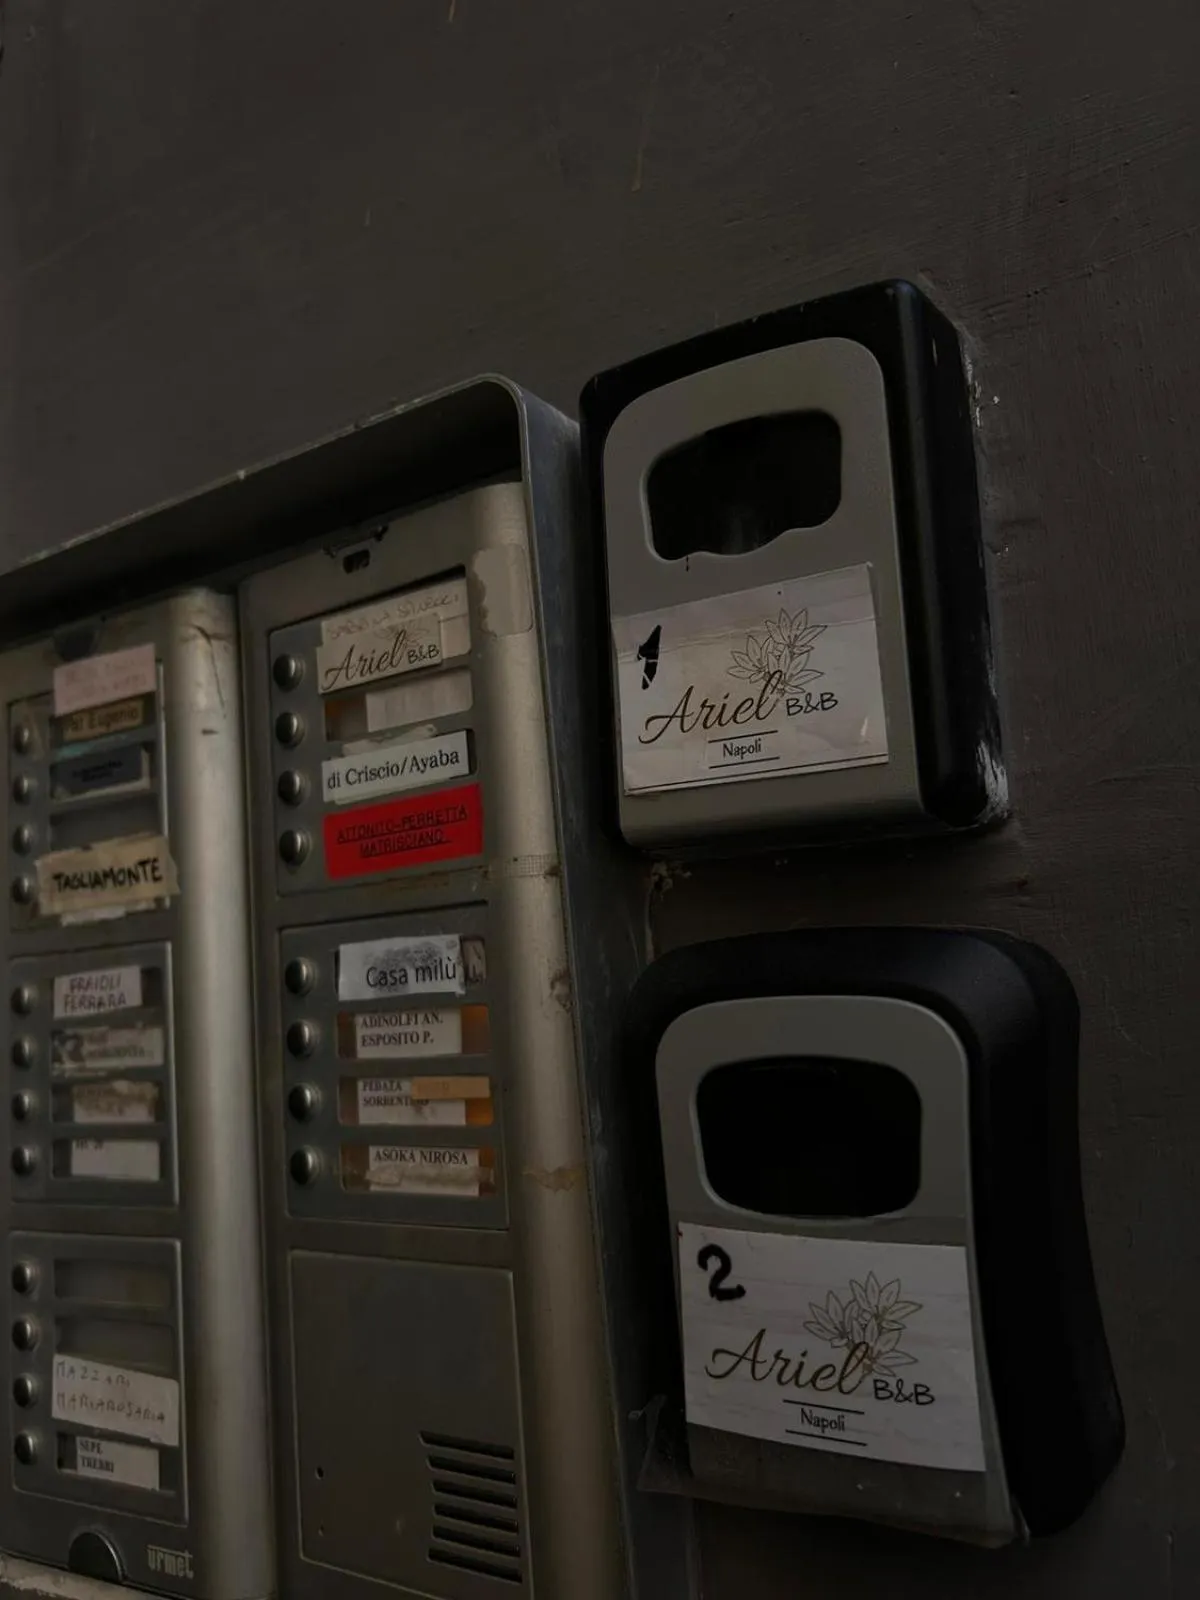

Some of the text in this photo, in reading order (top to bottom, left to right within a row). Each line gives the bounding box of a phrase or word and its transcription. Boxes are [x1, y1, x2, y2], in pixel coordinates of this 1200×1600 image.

[322, 629, 440, 691] Ariel B&B
[638, 670, 839, 744] Ariel B&B
[722, 737, 763, 760] Napoli
[327, 749, 460, 790] di Criscio/Ayaba
[52, 856, 163, 893] TAGLIAMONTE
[366, 956, 456, 988] Casa milù
[63, 992, 127, 1013] FERRARA
[360, 1030, 434, 1048] ESPOSITO P.
[373, 1148, 469, 1165] ASOKA NIROSA
[696, 1244, 747, 1301] 2
[704, 1327, 935, 1406] Ariel B&B
[800, 1407, 846, 1433] Napoli
[146, 1543, 195, 1579] urmet
